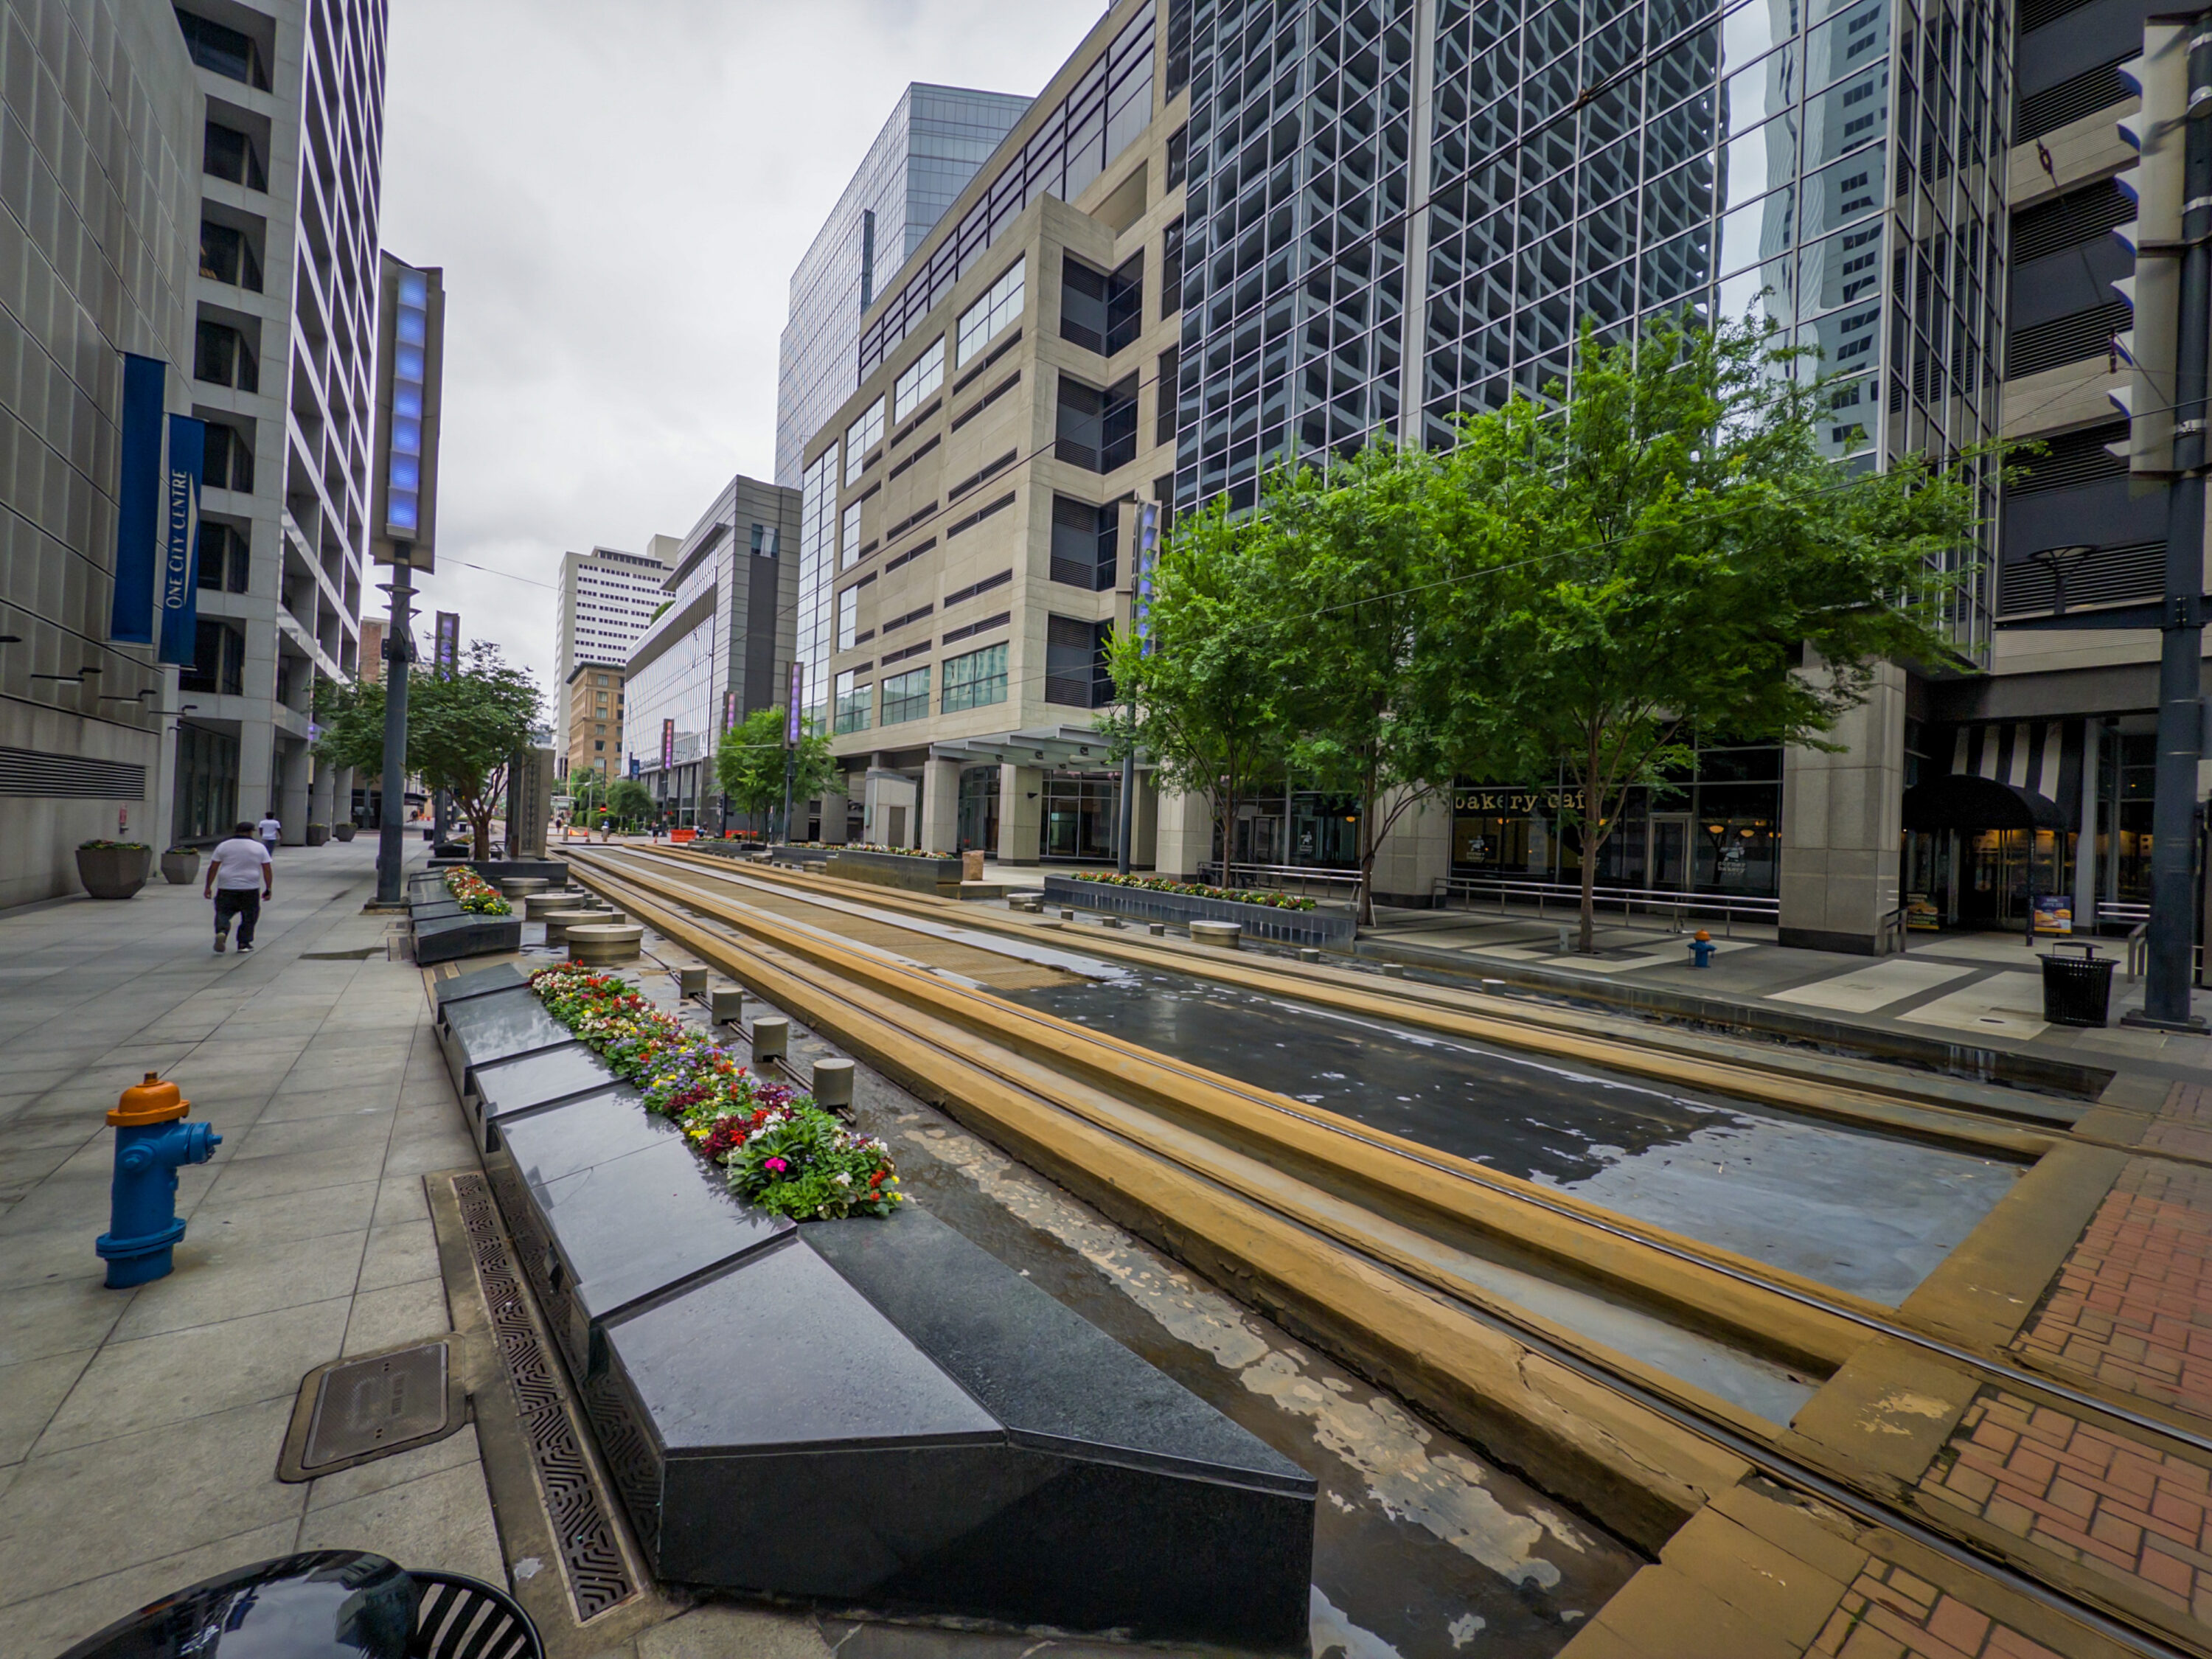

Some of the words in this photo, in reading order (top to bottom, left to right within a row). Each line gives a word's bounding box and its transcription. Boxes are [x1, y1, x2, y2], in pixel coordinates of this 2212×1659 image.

[172, 469, 187, 530] CENTRE
[168, 535, 184, 572] CITY
[165, 577, 182, 609] ONE
[1548, 790, 1586, 809] caf
